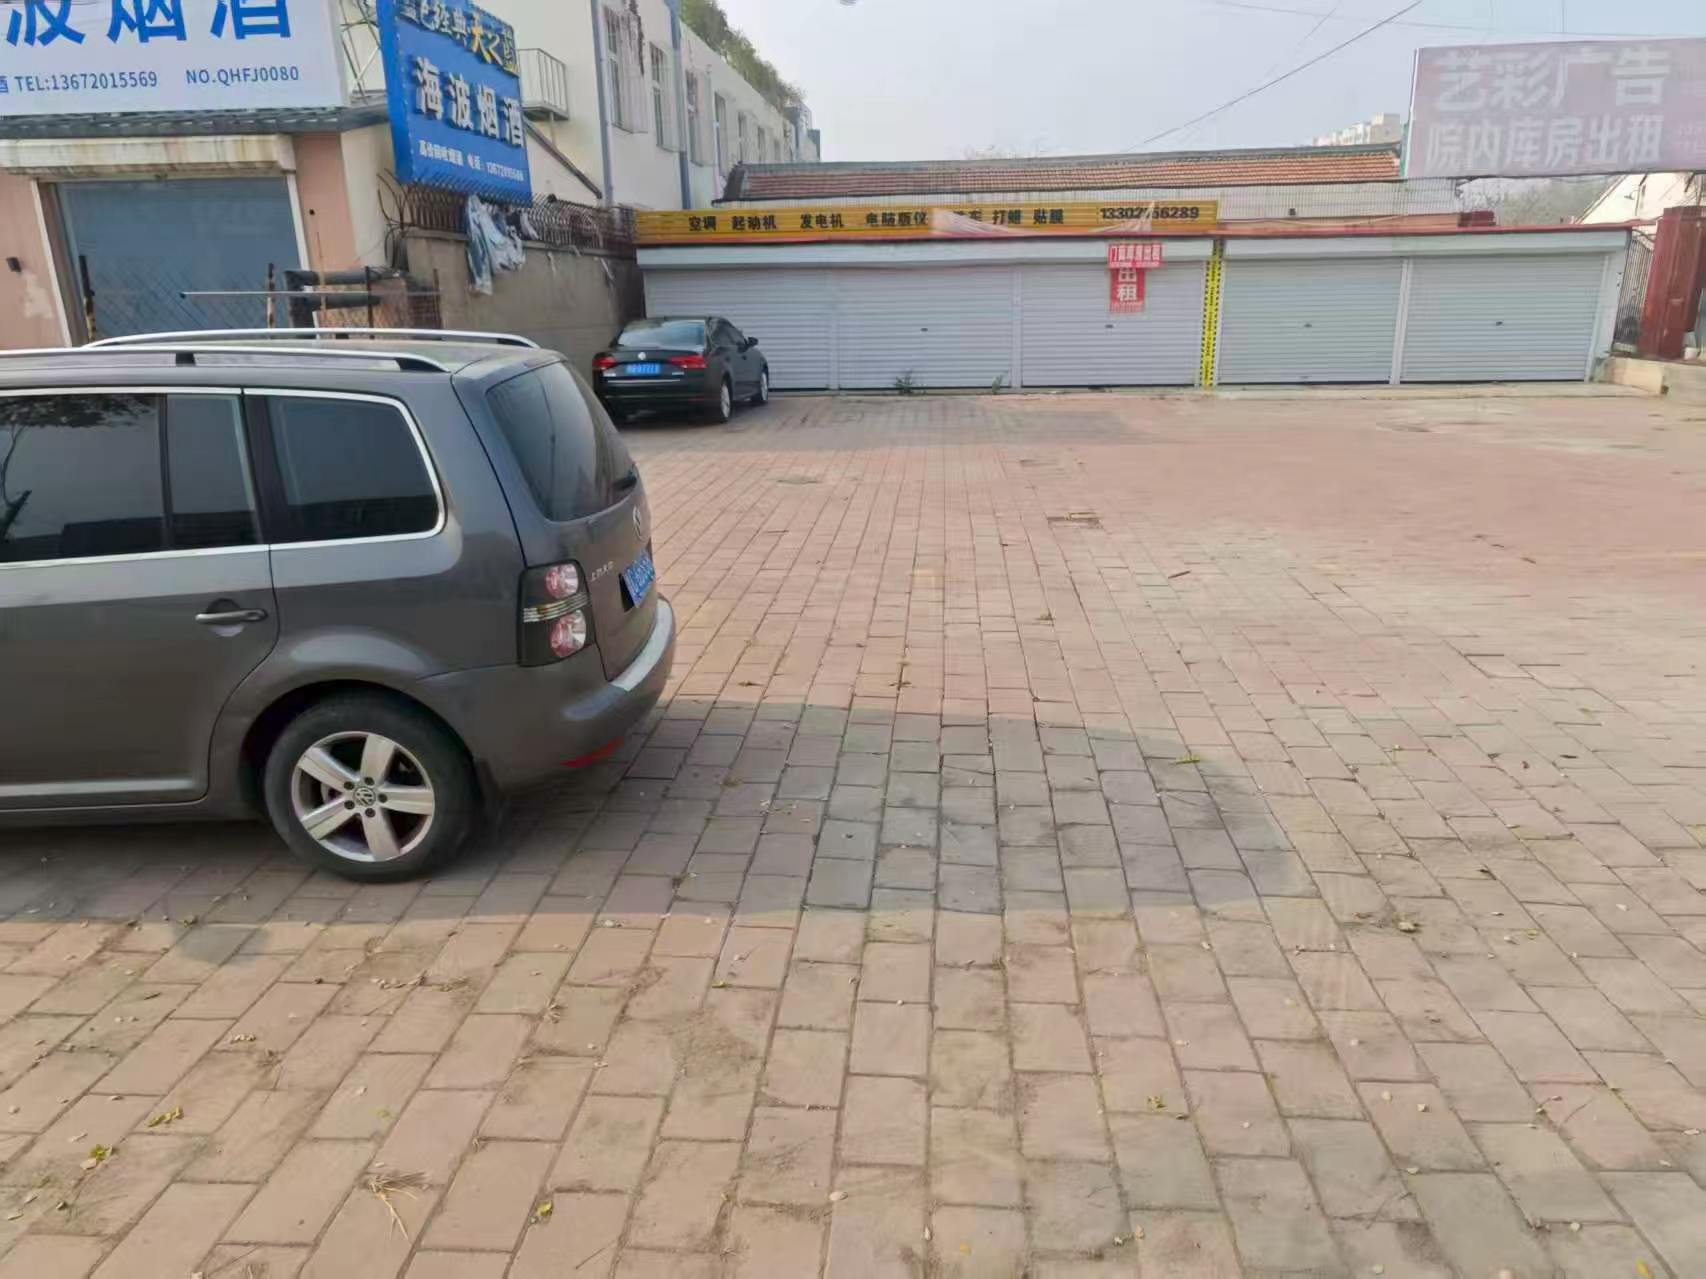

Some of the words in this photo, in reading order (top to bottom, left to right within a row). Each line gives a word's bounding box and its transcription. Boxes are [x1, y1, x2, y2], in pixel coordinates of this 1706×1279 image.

[15, 71, 158, 93] TEL:13672015569
[186, 66, 299, 86] NO.QHFJ0080
[413, 57, 524, 148] 海波烟酒
[1437, 48, 1671, 114] 艺彩广告
[1425, 115, 1665, 174] 院内库房出租
[688, 215, 717, 231] 空调
[731, 214, 777, 231] 起动机
[800, 212, 844, 229] 发电机
